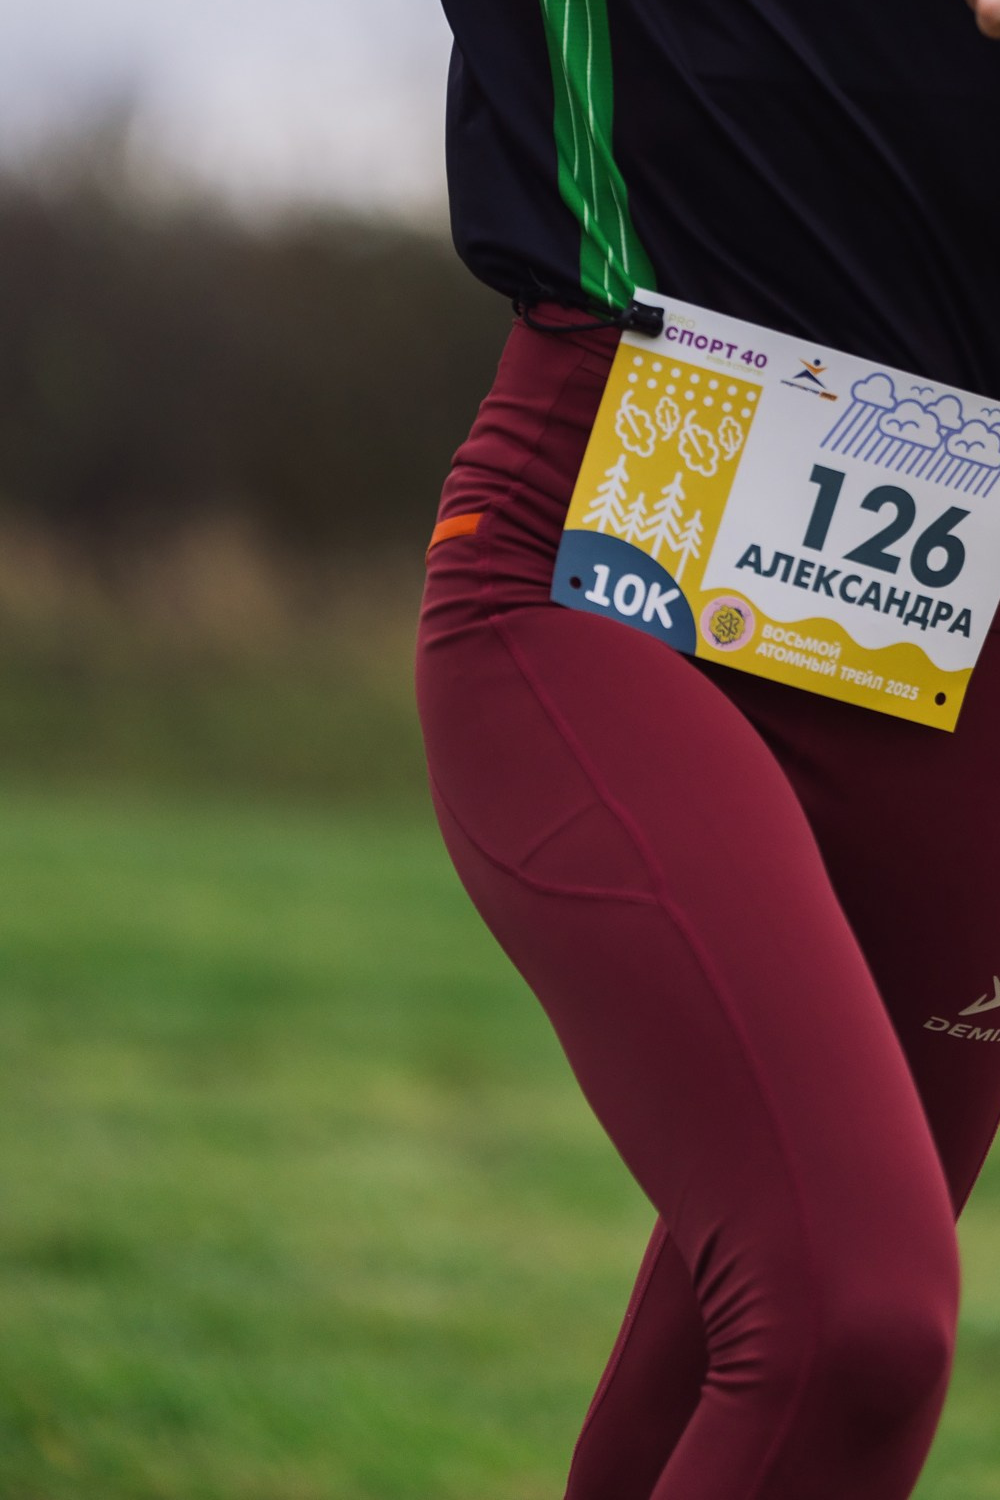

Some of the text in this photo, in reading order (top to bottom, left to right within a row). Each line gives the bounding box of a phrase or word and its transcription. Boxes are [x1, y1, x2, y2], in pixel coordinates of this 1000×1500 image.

[665, 326, 739, 359] СПОРТ
[740, 350, 768, 368] 40
[801, 464, 971, 589] 126
[584, 564, 681, 630] 10K
[735, 544, 972, 638] АЛЕКСАНДРА
[755, 642, 920, 701] АТОМНЫЙ ТРЕЙЛ 2025
[761, 623, 841, 660] ВОСЬМОЙ
